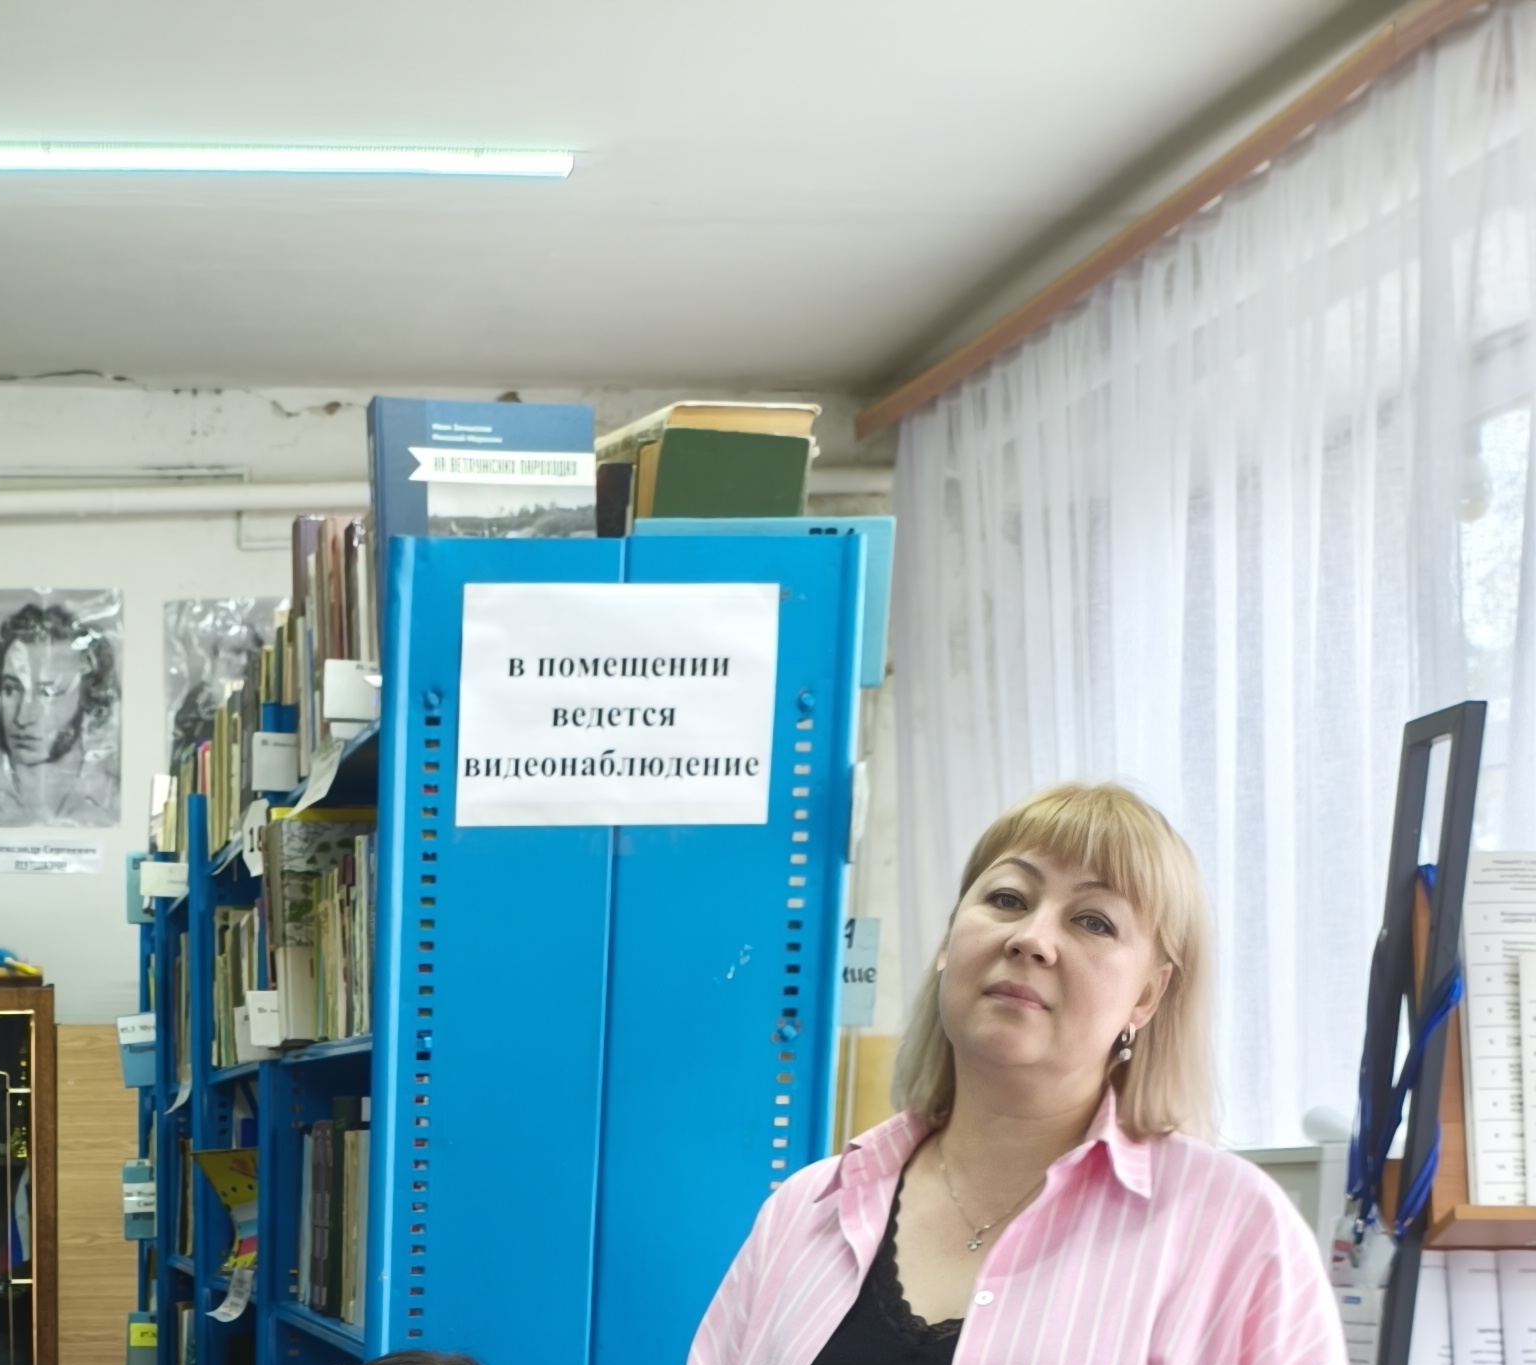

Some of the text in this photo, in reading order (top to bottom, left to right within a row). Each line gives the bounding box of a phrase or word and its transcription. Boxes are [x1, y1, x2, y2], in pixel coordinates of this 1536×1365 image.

[537, 656, 731, 680] помещении
[551, 706, 677, 730] ведется
[464, 748, 761, 779] видеонаблюдение
